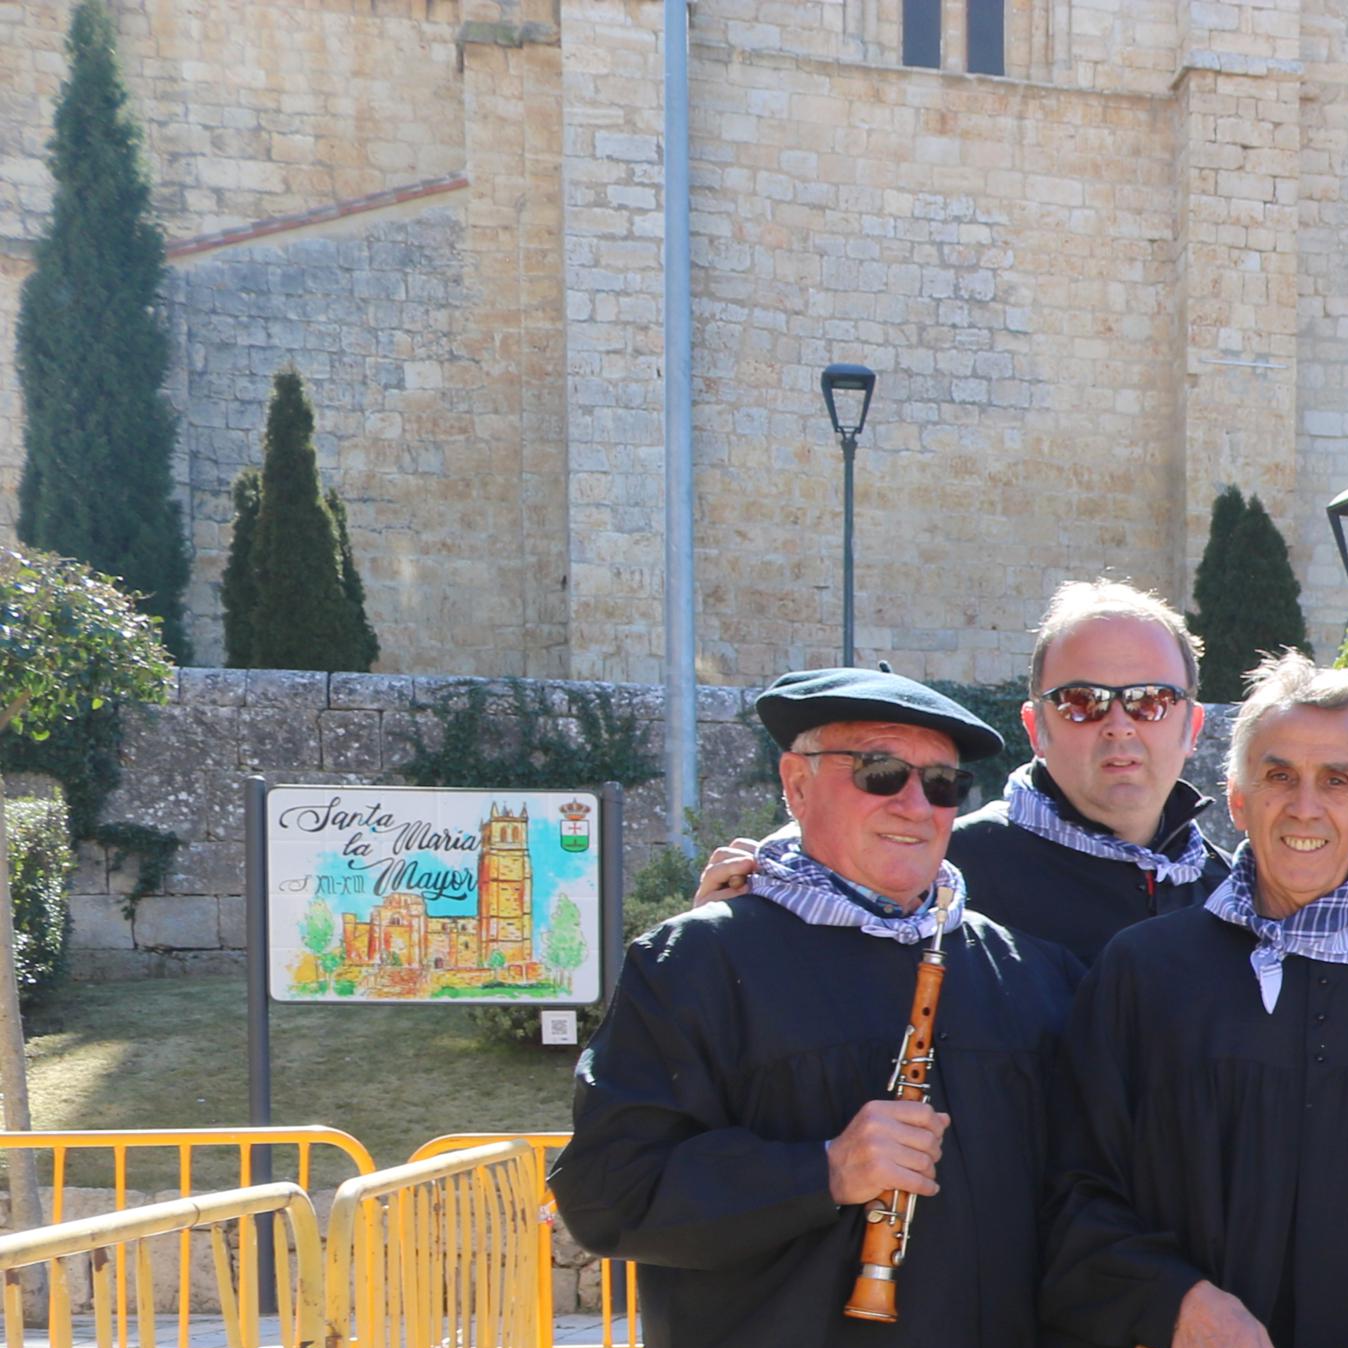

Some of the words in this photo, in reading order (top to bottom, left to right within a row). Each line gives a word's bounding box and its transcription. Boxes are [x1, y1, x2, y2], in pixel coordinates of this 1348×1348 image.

[279, 796, 395, 832] Santa
[342, 832, 373, 856] la
[347, 857, 479, 901] Mayor
